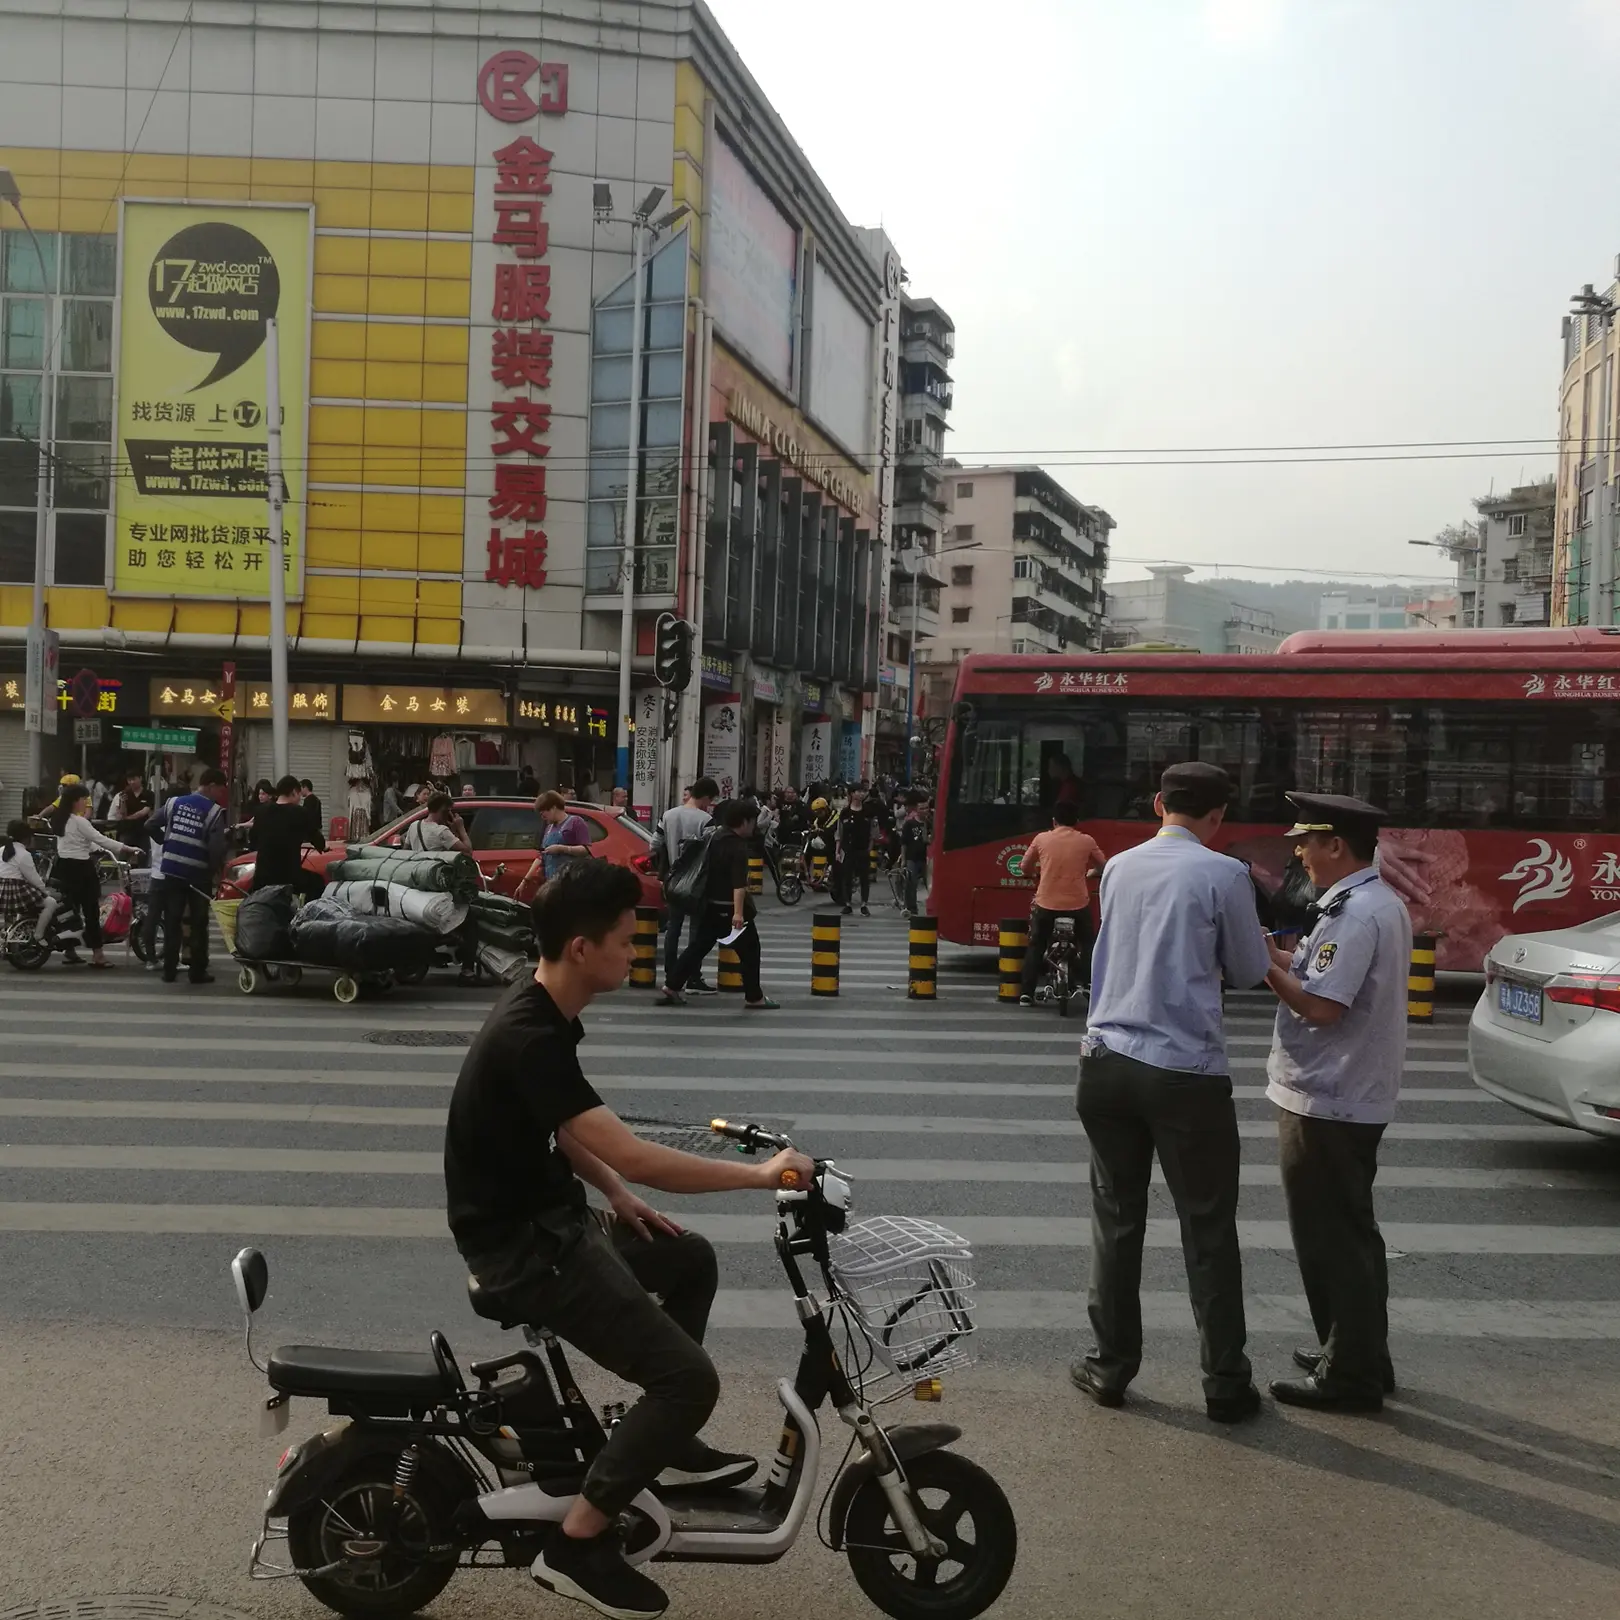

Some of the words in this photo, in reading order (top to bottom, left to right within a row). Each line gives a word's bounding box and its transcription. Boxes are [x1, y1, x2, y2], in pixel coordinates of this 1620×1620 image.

[199, 261, 260, 274] zwd.com
[156, 306, 259, 321] www.17zwd.com
[485, 135, 554, 591] 金马服装交易城
[132, 402, 196, 423] 找货源
[1060, 672, 1129, 686] 永华红木
[379, 693, 472, 714] 金马女装
